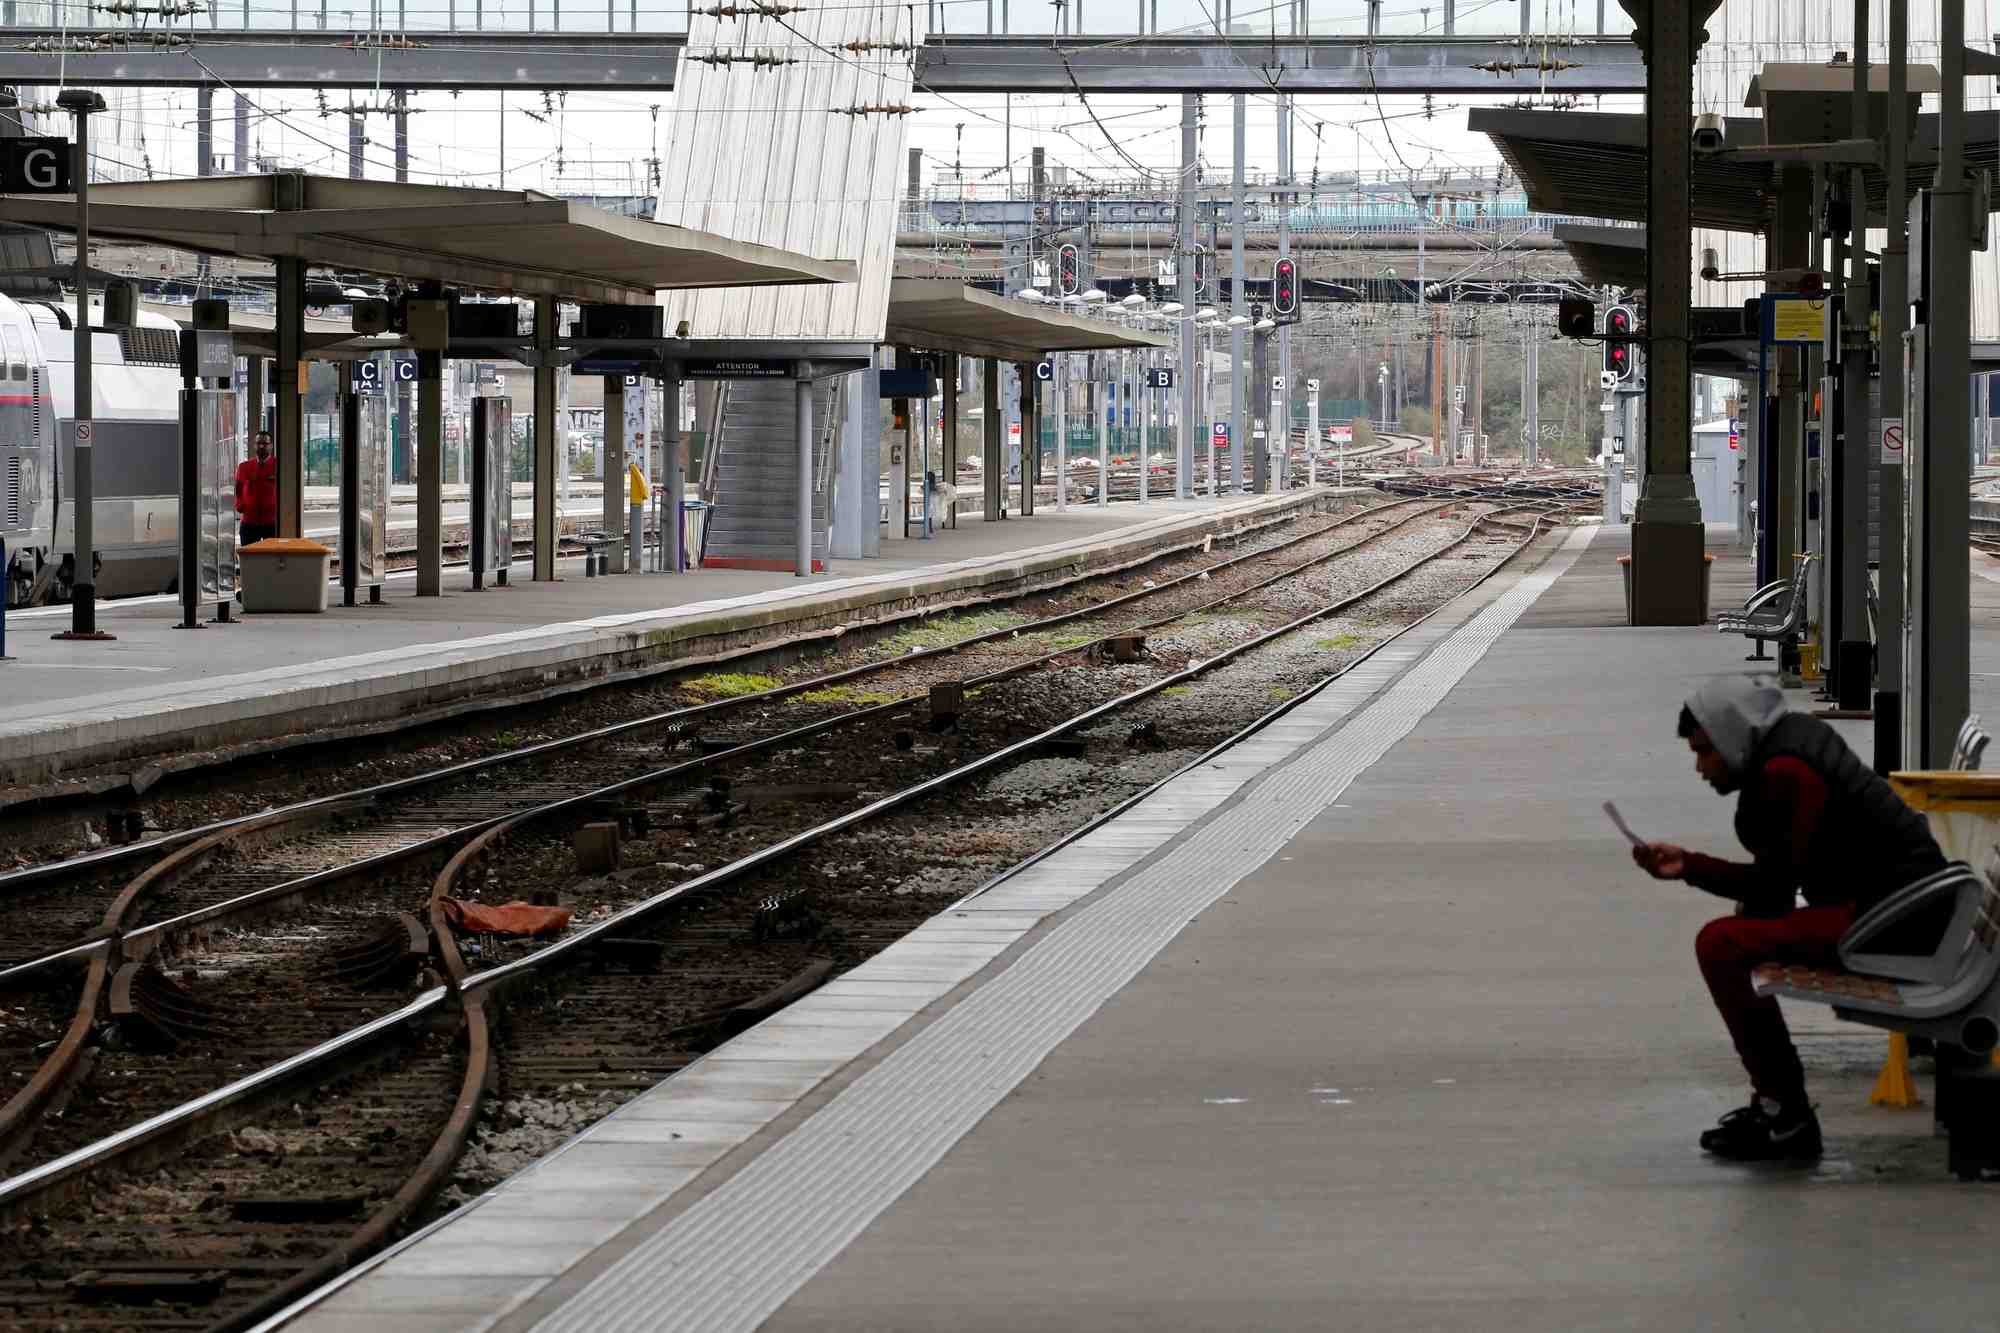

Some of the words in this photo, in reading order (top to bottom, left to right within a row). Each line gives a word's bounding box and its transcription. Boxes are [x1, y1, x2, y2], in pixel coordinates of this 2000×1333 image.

[24, 148, 57, 188] G
[361, 362, 375, 380] C
[400, 362, 413, 380] C
[716, 362, 760, 370] ATTENTION
[1036, 362, 1050, 379] C
[1158, 372, 1169, 386] B
